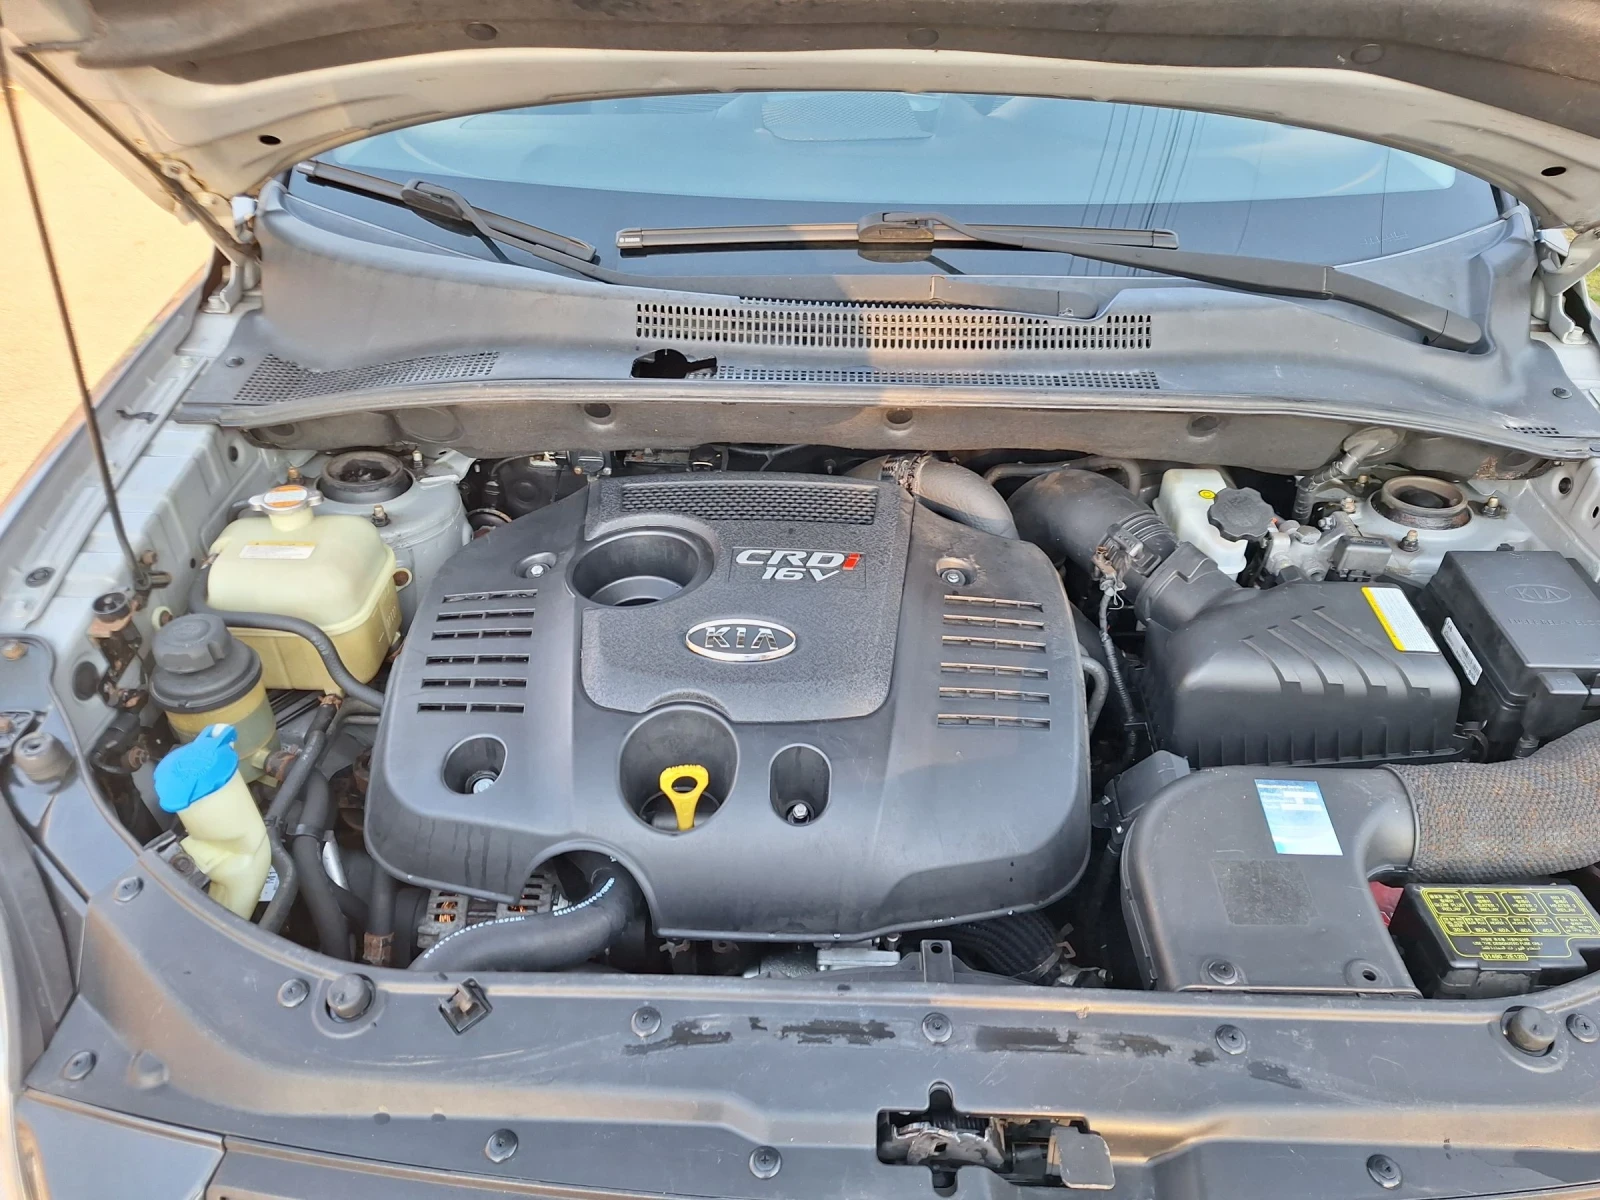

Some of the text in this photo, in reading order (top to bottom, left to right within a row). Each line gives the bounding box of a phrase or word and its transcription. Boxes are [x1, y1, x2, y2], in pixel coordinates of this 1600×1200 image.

[735, 549, 863, 571] CRDi
[761, 566, 840, 582] 16V
[1514, 586, 1561, 600] KIA
[704, 626, 779, 651] KIA
